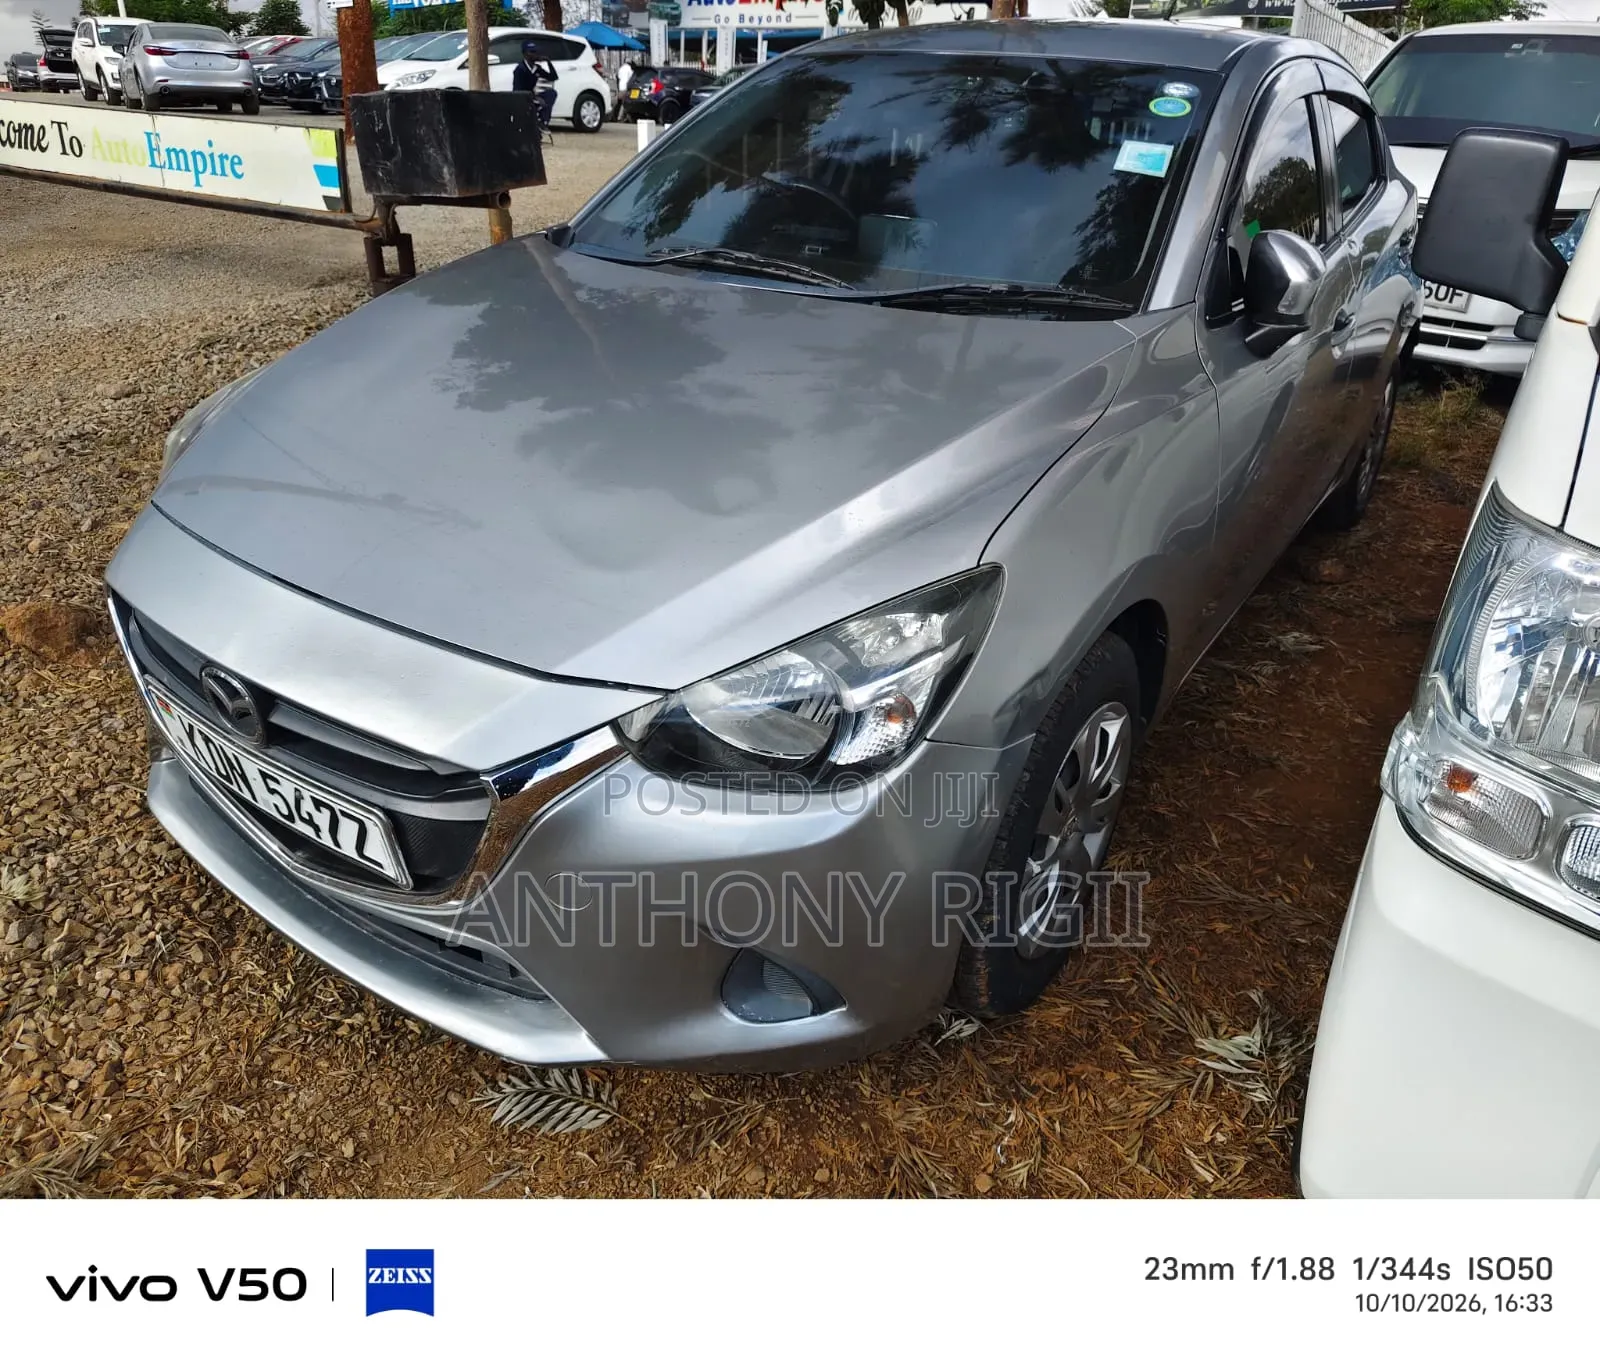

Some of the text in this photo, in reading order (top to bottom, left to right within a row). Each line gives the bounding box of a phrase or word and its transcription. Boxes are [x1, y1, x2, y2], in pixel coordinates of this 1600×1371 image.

[714, 13, 792, 25] Go Beyond
[51, 120, 83, 158] To
[177, 713, 384, 869] KDN 547Z
